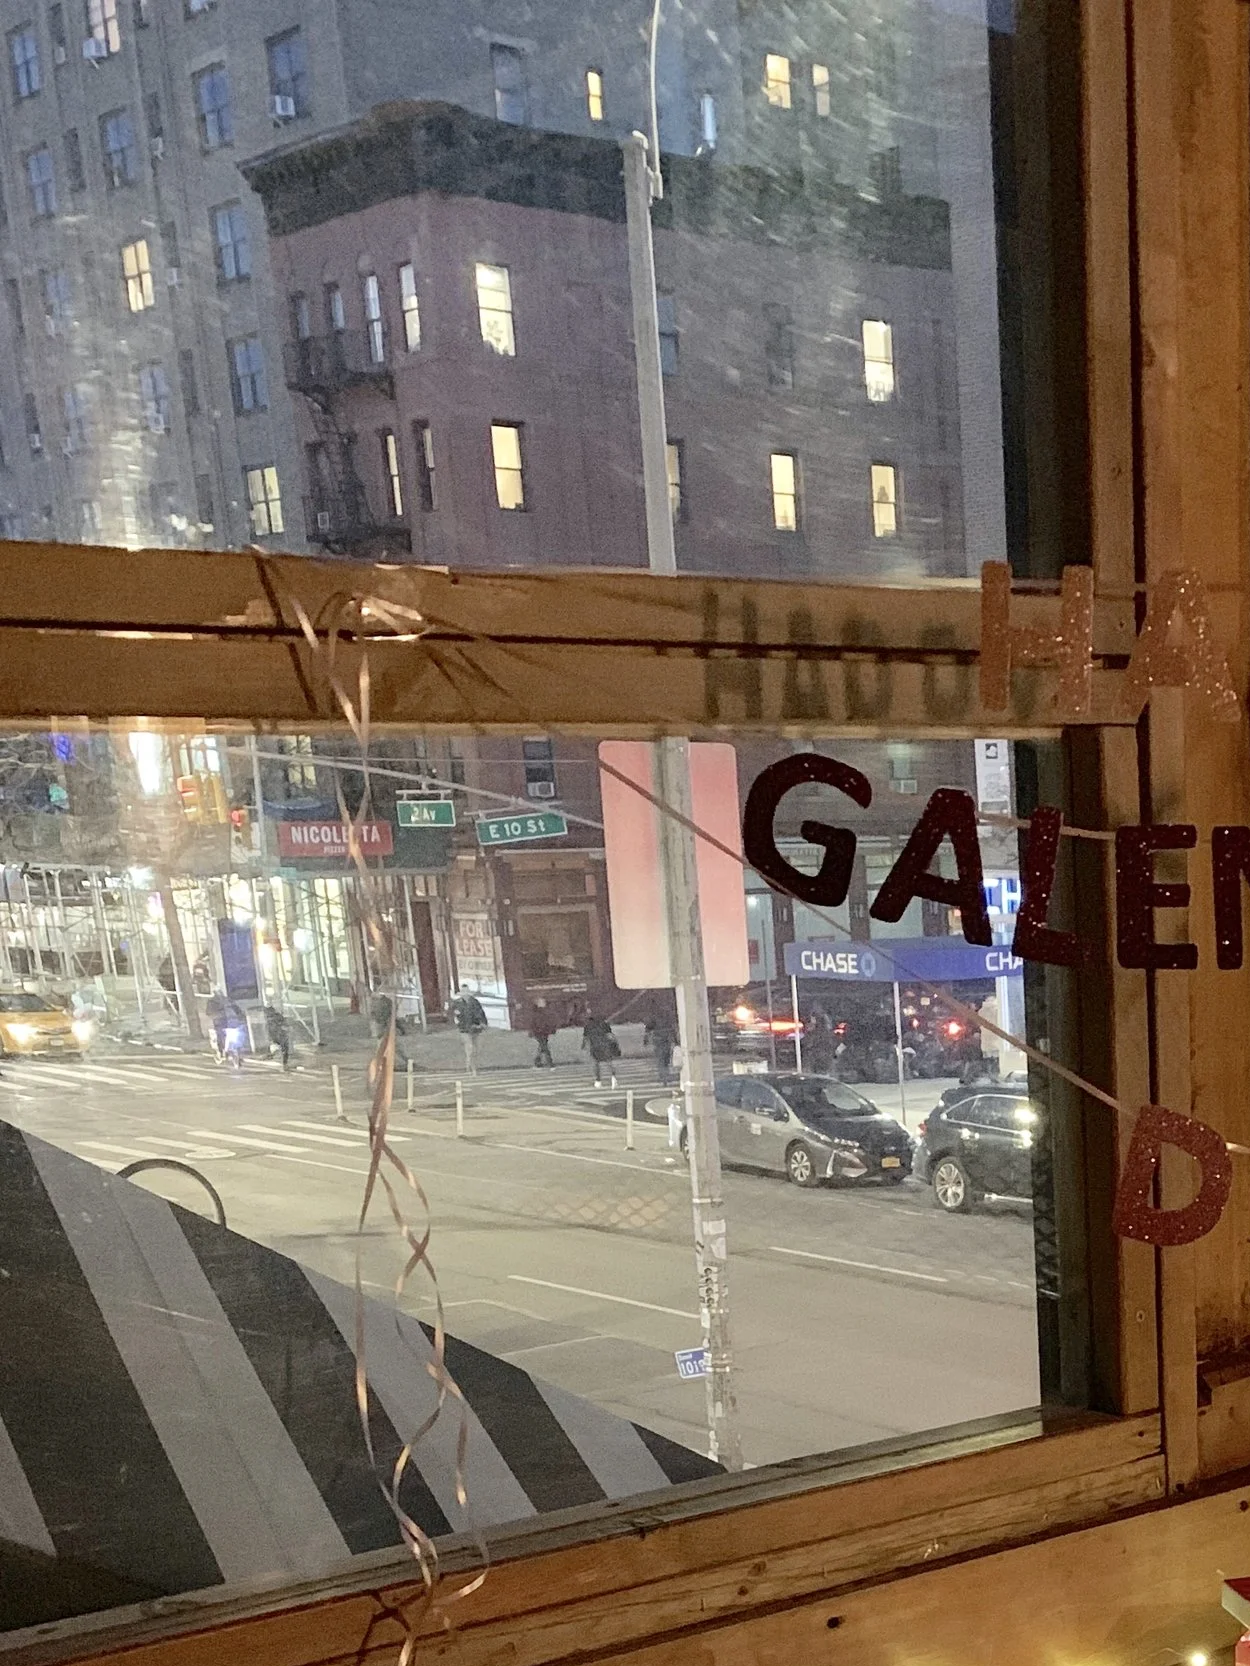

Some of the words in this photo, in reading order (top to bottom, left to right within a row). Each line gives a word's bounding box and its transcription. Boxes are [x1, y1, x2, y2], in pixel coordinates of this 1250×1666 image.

[291, 825, 380, 844] NICOLETA
[488, 824, 500, 839] E
[504, 822, 521, 836] 10
[527, 819, 546, 834] St
[460, 921, 484, 938] FOR
[456, 939, 493, 957] LEASE
[801, 950, 859, 974] CHASE
[985, 952, 1024, 971] CHA
